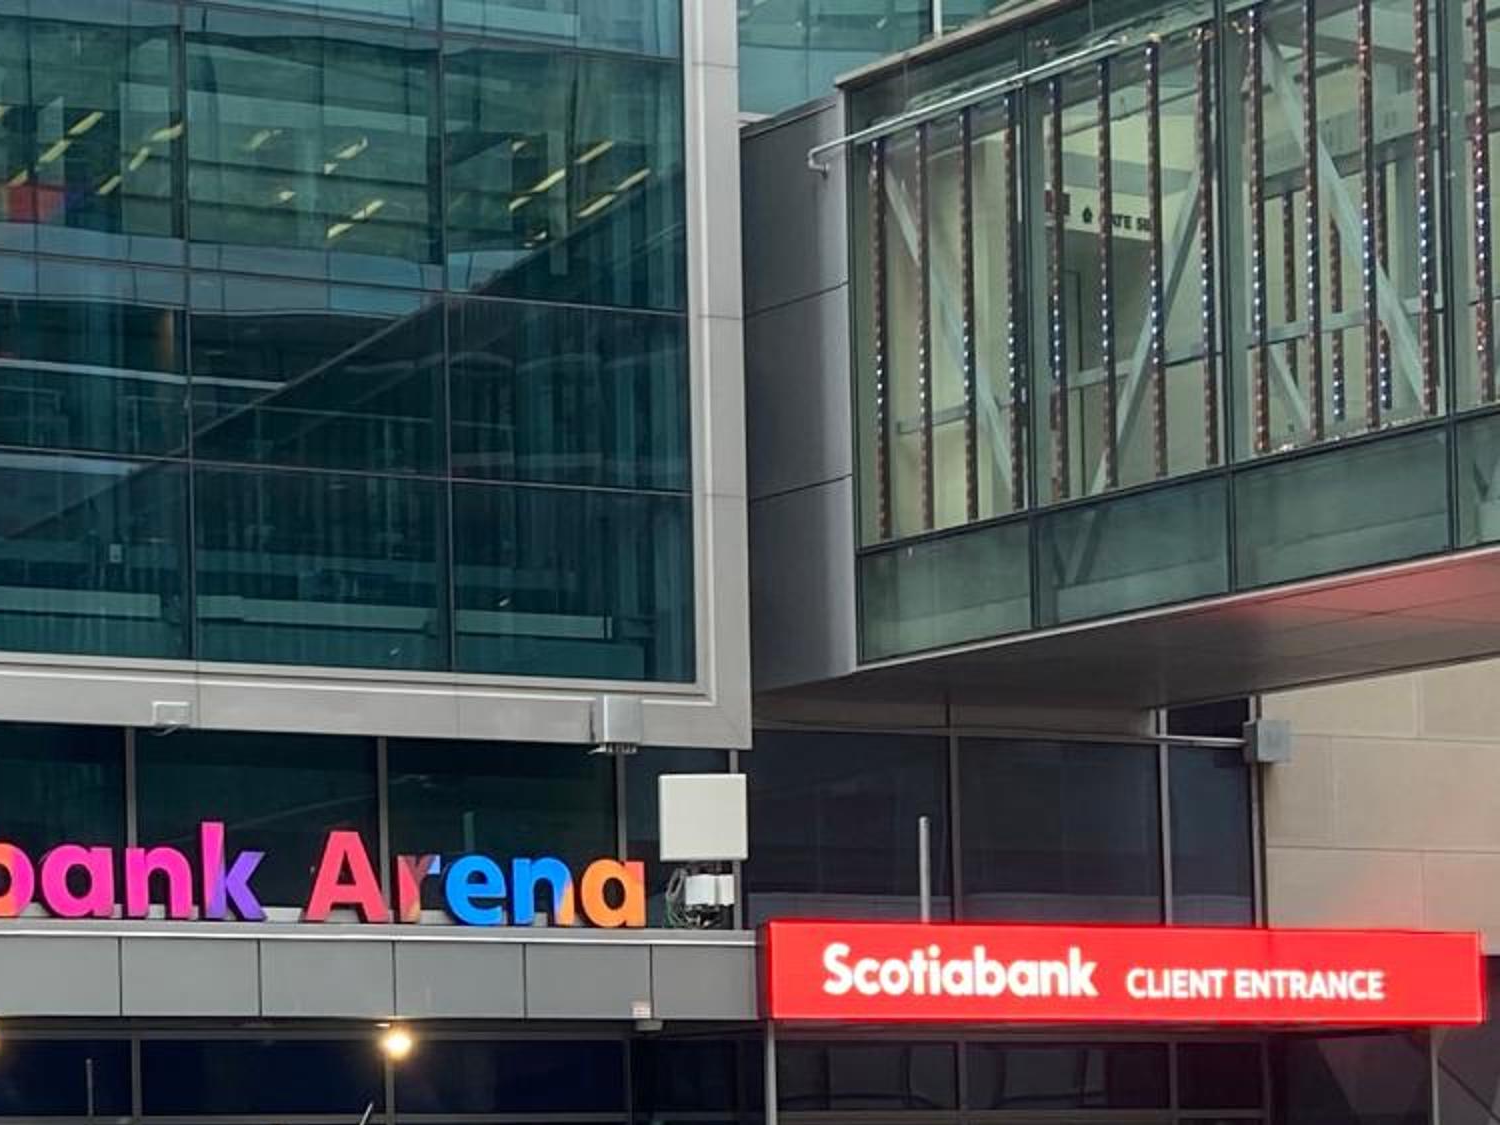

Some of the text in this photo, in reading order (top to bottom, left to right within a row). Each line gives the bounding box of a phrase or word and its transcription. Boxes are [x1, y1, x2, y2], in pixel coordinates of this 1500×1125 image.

[303, 830, 646, 928] Arena
[822, 941, 1386, 1002] Scotiabank CLIENT ENTRANCE
